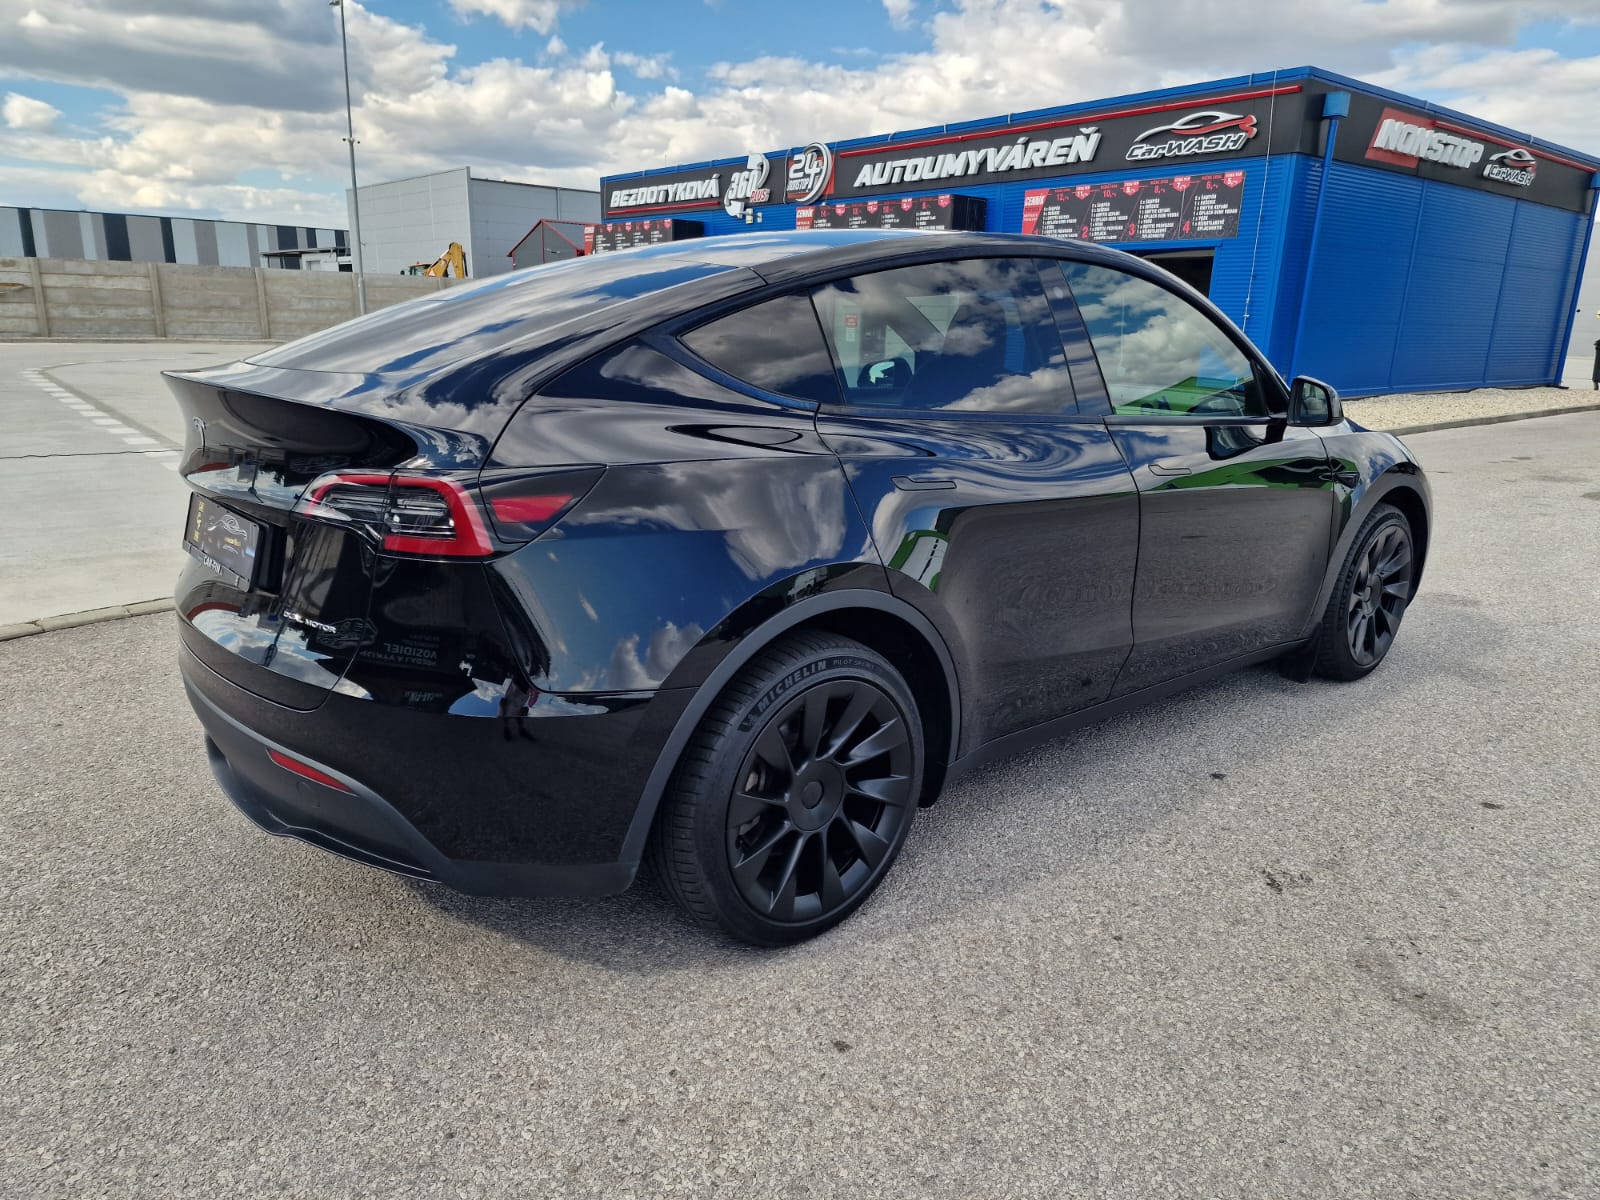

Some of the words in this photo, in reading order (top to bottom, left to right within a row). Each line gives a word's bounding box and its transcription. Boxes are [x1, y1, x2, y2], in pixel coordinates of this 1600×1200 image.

[852, 126, 1102, 188] AUTOUMYVÁREŇ
[1373, 118, 1485, 169] NONSTOP
[728, 170, 762, 199] 360
[789, 152, 821, 190] 24
[610, 173, 721, 208] BEZDOTYKOVÁ
[1081, 226, 1089, 239] 2
[1128, 223, 1136, 236] 3
[1183, 220, 1191, 234] 4
[305, 618, 337, 634] MOTOR
[757, 660, 827, 713] MICHELIN
